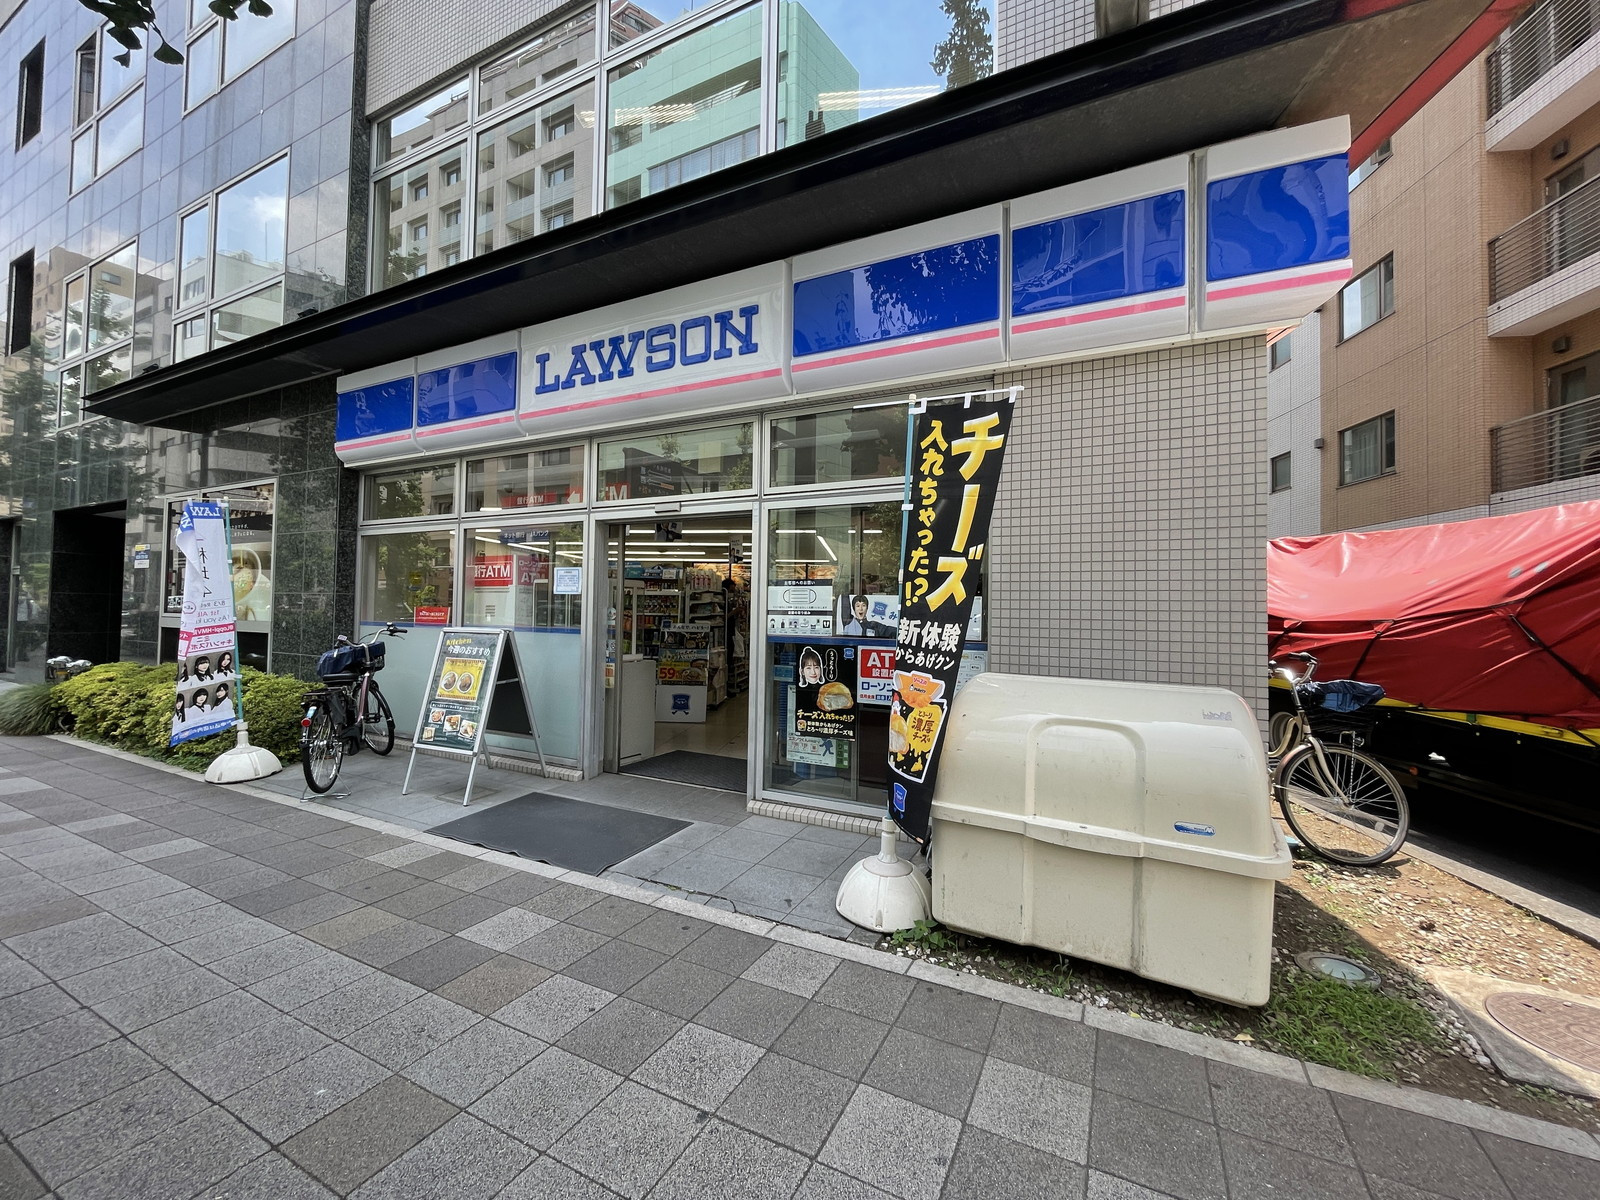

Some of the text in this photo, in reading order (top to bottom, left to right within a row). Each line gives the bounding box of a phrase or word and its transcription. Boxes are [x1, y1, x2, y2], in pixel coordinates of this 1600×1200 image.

[535, 304, 759, 395] LAWSON
[925, 412, 1004, 612] チーズ
[897, 617, 963, 653] 新体験
[448, 645, 491, 656] 今週のおすすめ
[895, 646, 956, 671] からあげクン
[911, 717, 935, 733] 濃厚
